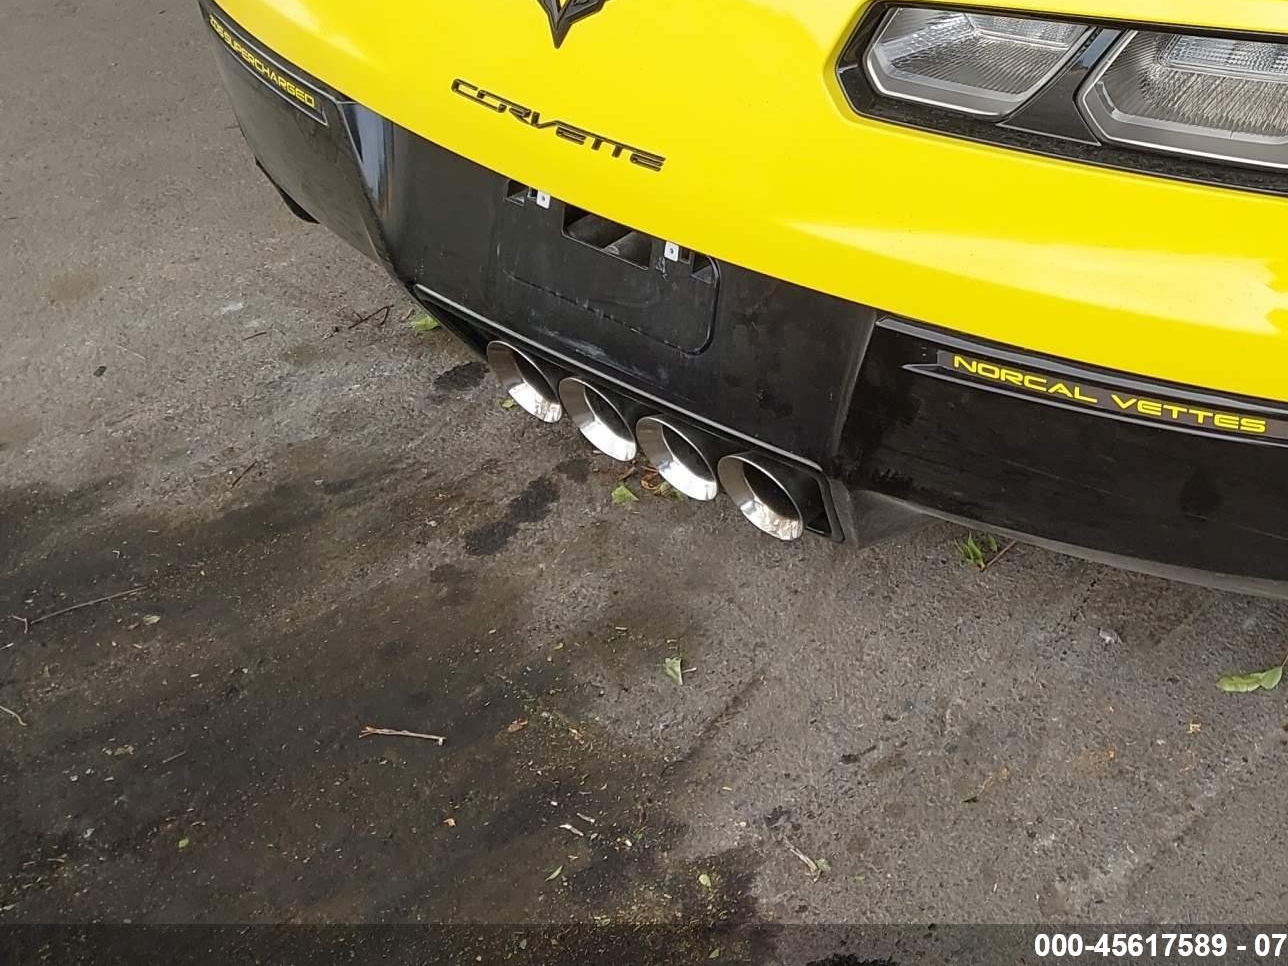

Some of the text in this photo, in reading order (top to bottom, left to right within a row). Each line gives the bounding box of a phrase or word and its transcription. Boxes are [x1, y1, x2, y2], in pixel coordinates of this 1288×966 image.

[451, 78, 667, 172] CORVETTE
[954, 355, 1266, 433] NORCAL VETTES
